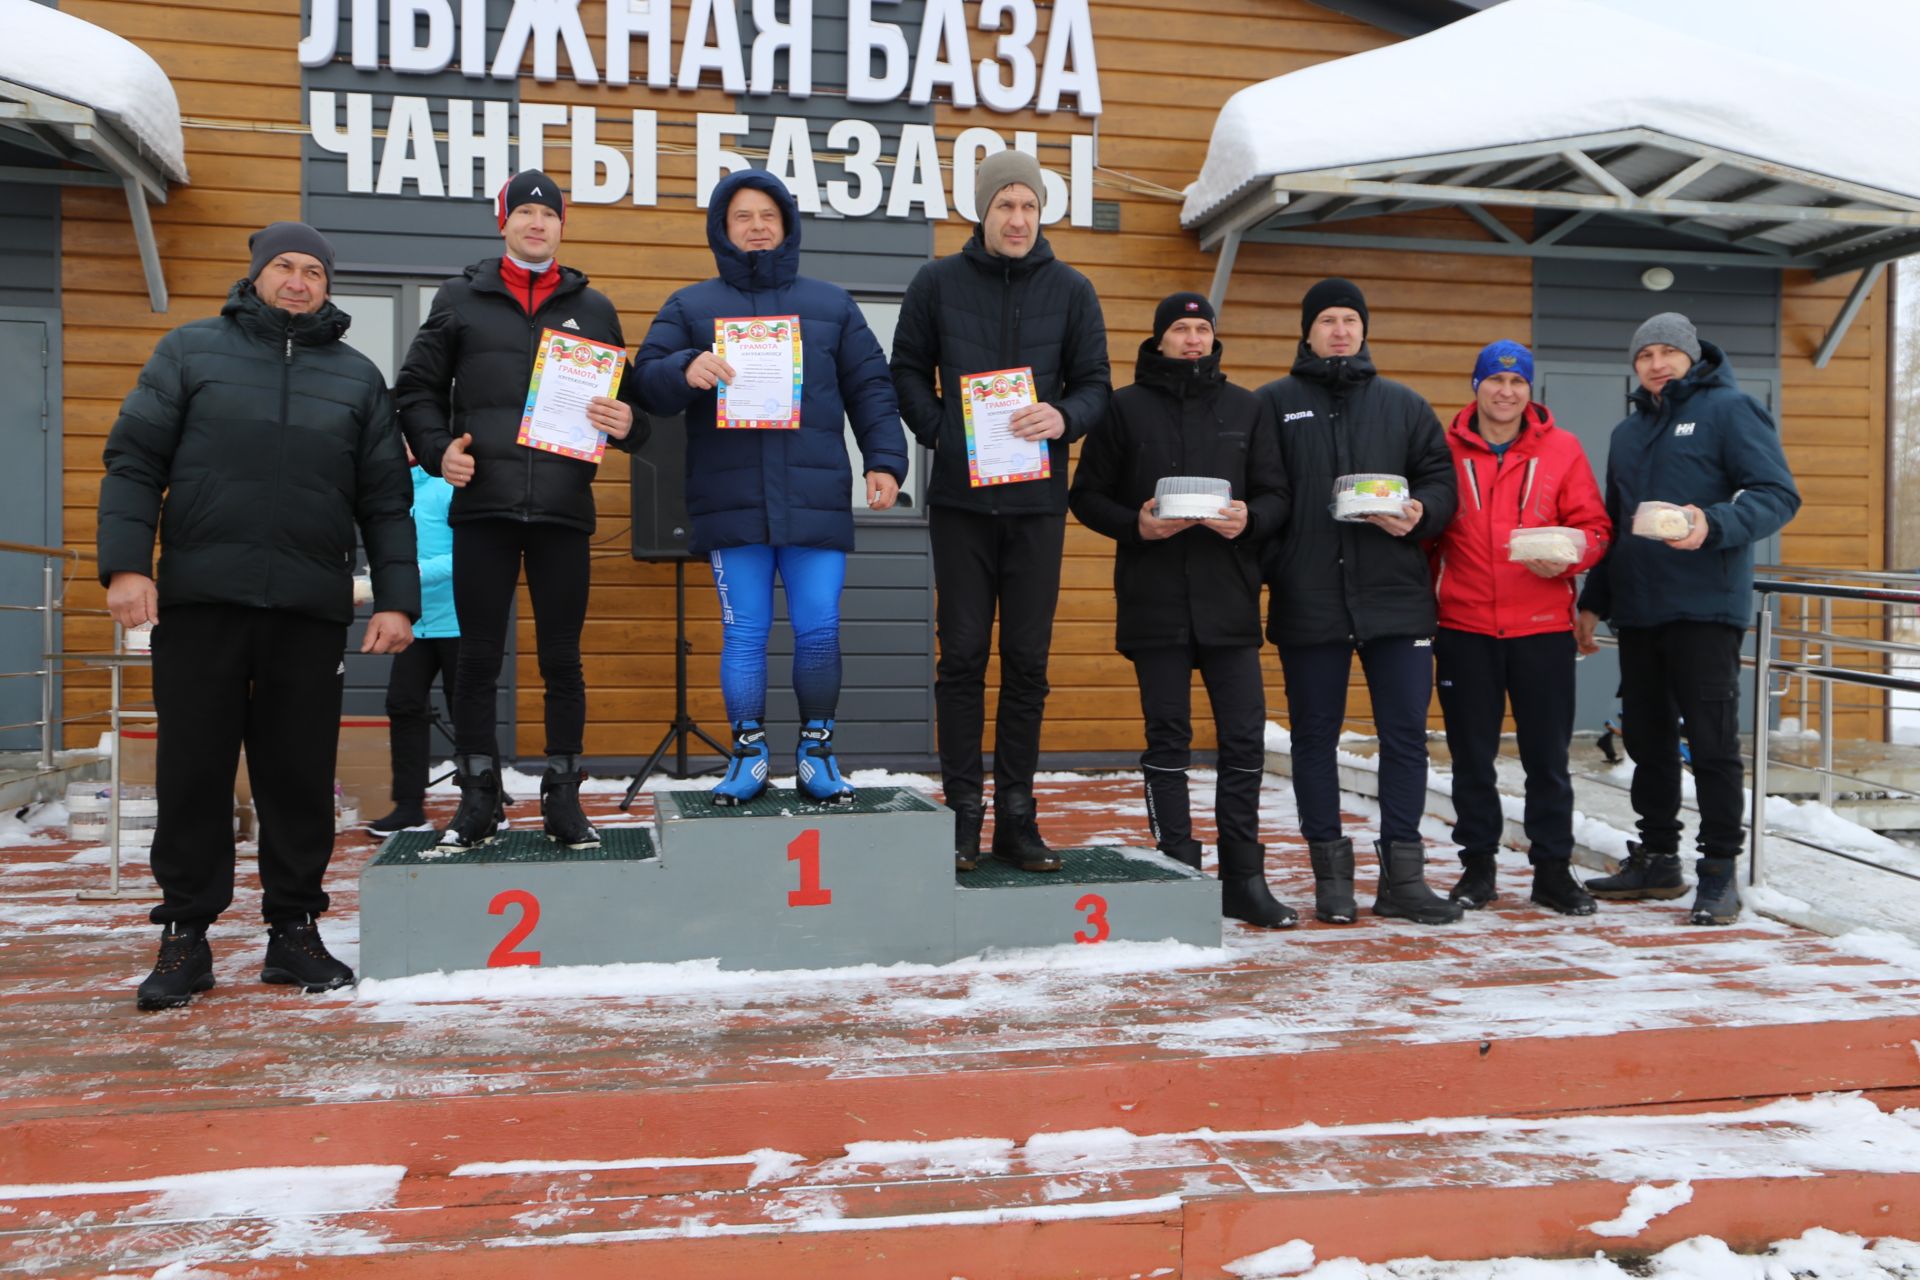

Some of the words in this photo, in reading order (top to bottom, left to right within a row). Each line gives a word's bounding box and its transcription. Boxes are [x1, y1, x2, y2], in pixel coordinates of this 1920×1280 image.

[298, 0, 812, 97] ЛЫЖНАЯ
[846, 0, 1103, 117] БАЗА
[558, 364, 597, 380] ГРАМОТА
[786, 828, 833, 908] 1
[487, 889, 542, 969] 2
[1073, 893, 1111, 945] 3
